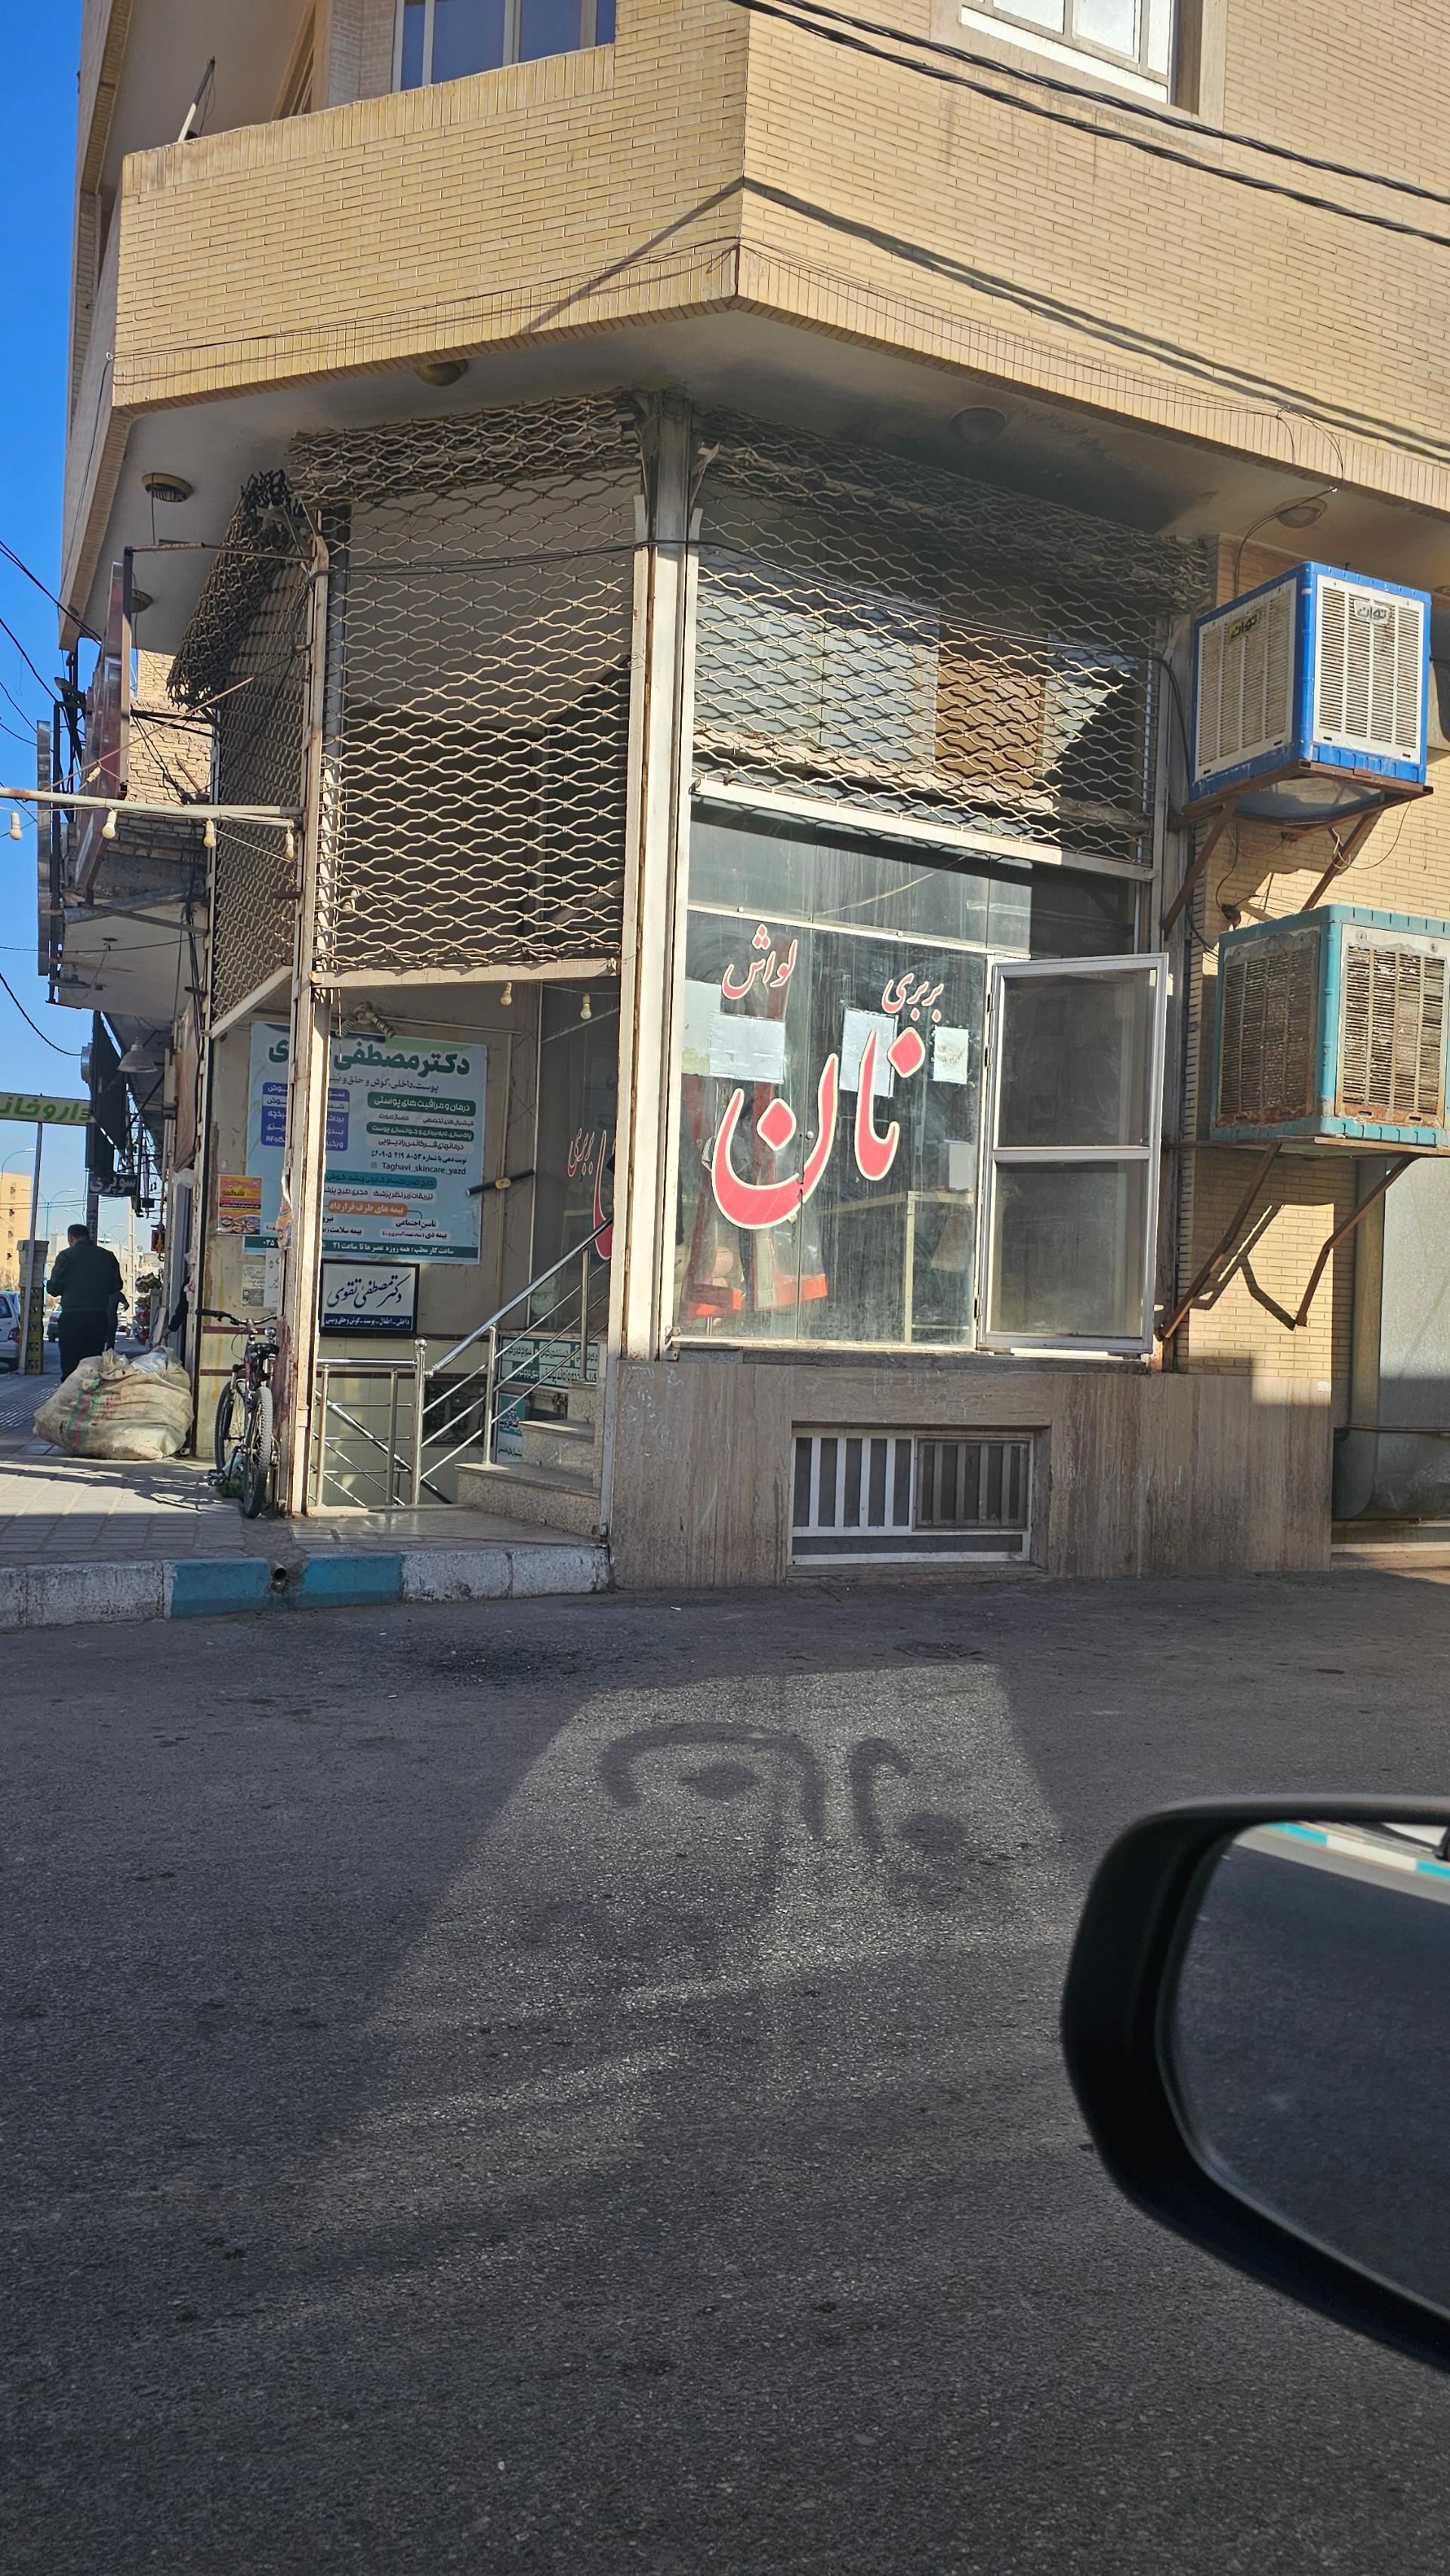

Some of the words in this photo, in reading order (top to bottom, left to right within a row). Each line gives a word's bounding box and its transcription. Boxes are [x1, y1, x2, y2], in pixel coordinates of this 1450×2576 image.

[720, 923, 799, 1000] لواش
[881, 971, 944, 1023] بربری
[334, 1041, 419, 1070] مصطفی
[418, 1052, 470, 1078] دکتر
[374, 1095, 400, 1108] پوستی
[417, 1098, 445, 1110] مراقبت
[450, 1101, 470, 1112] درمان
[0, 1096, 91, 1121] داروخان
[711, 1026, 927, 1229] نان
[382, 1162, 467, 1175] Taghavi_skincare_yazd
[89, 1175, 137, 1195] سوپری
[374, 1204, 389, 1214] های
[390, 1206, 404, 1215] بیمه
[329, 1226, 350, 1234] سلامت
[350, 1228, 362, 1237] بیمه
[341, 1242, 357, 1250] ساعت
[385, 1245, 399, 1253] روزه
[429, 1246, 438, 1255] کار
[326, 1278, 362, 1308] تقوی
[353, 1280, 393, 1309] مصطفی
[376, 1273, 412, 1308] دکتر
